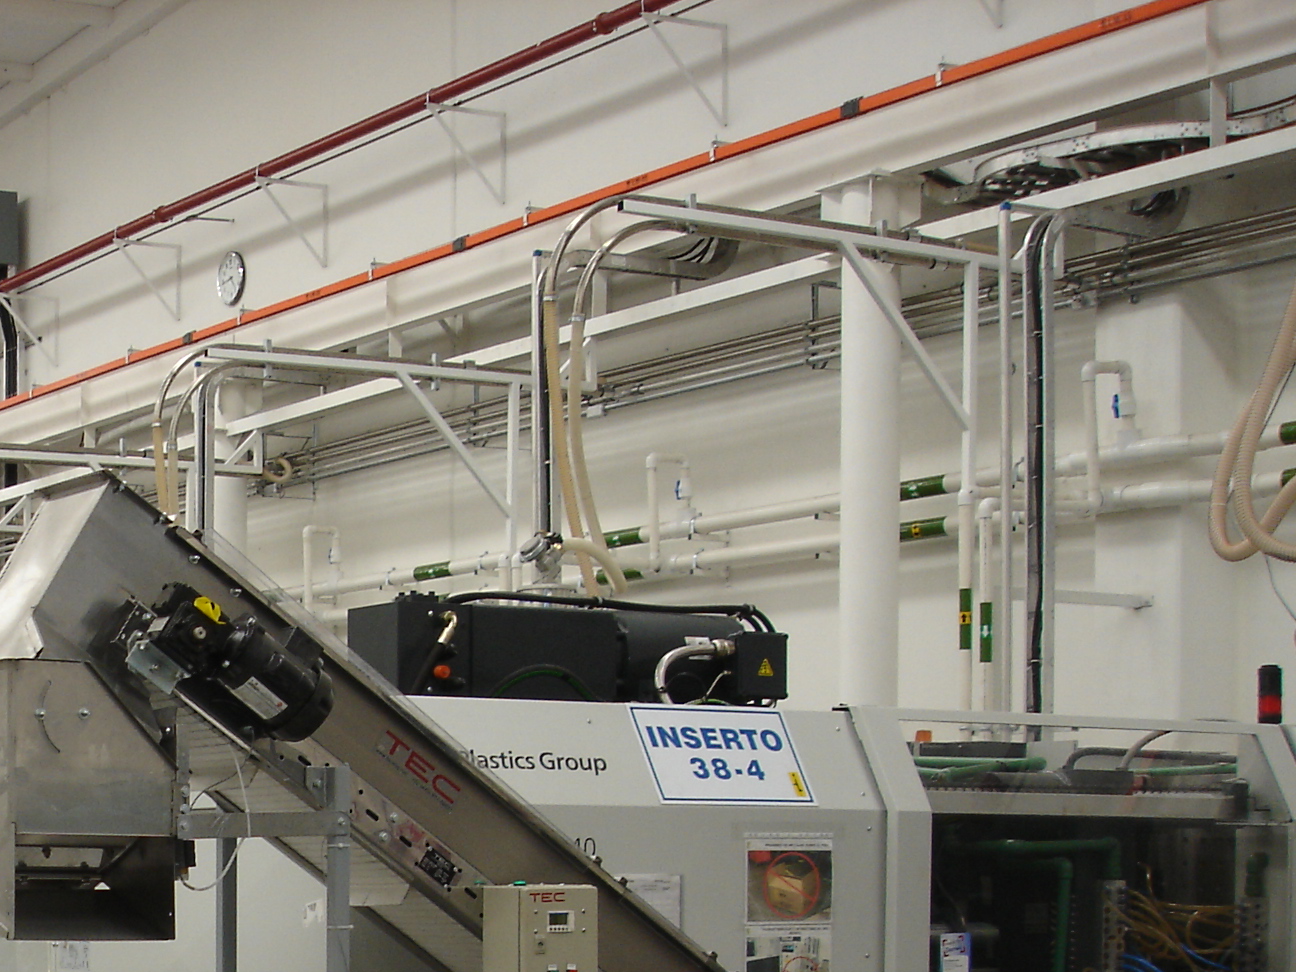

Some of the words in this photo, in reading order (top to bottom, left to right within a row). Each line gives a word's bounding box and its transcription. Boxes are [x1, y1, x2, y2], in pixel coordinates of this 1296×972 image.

[645, 725, 784, 752] INSERTO
[385, 730, 461, 805] TEC
[539, 752, 608, 776] Group
[529, 892, 566, 903] TEC
